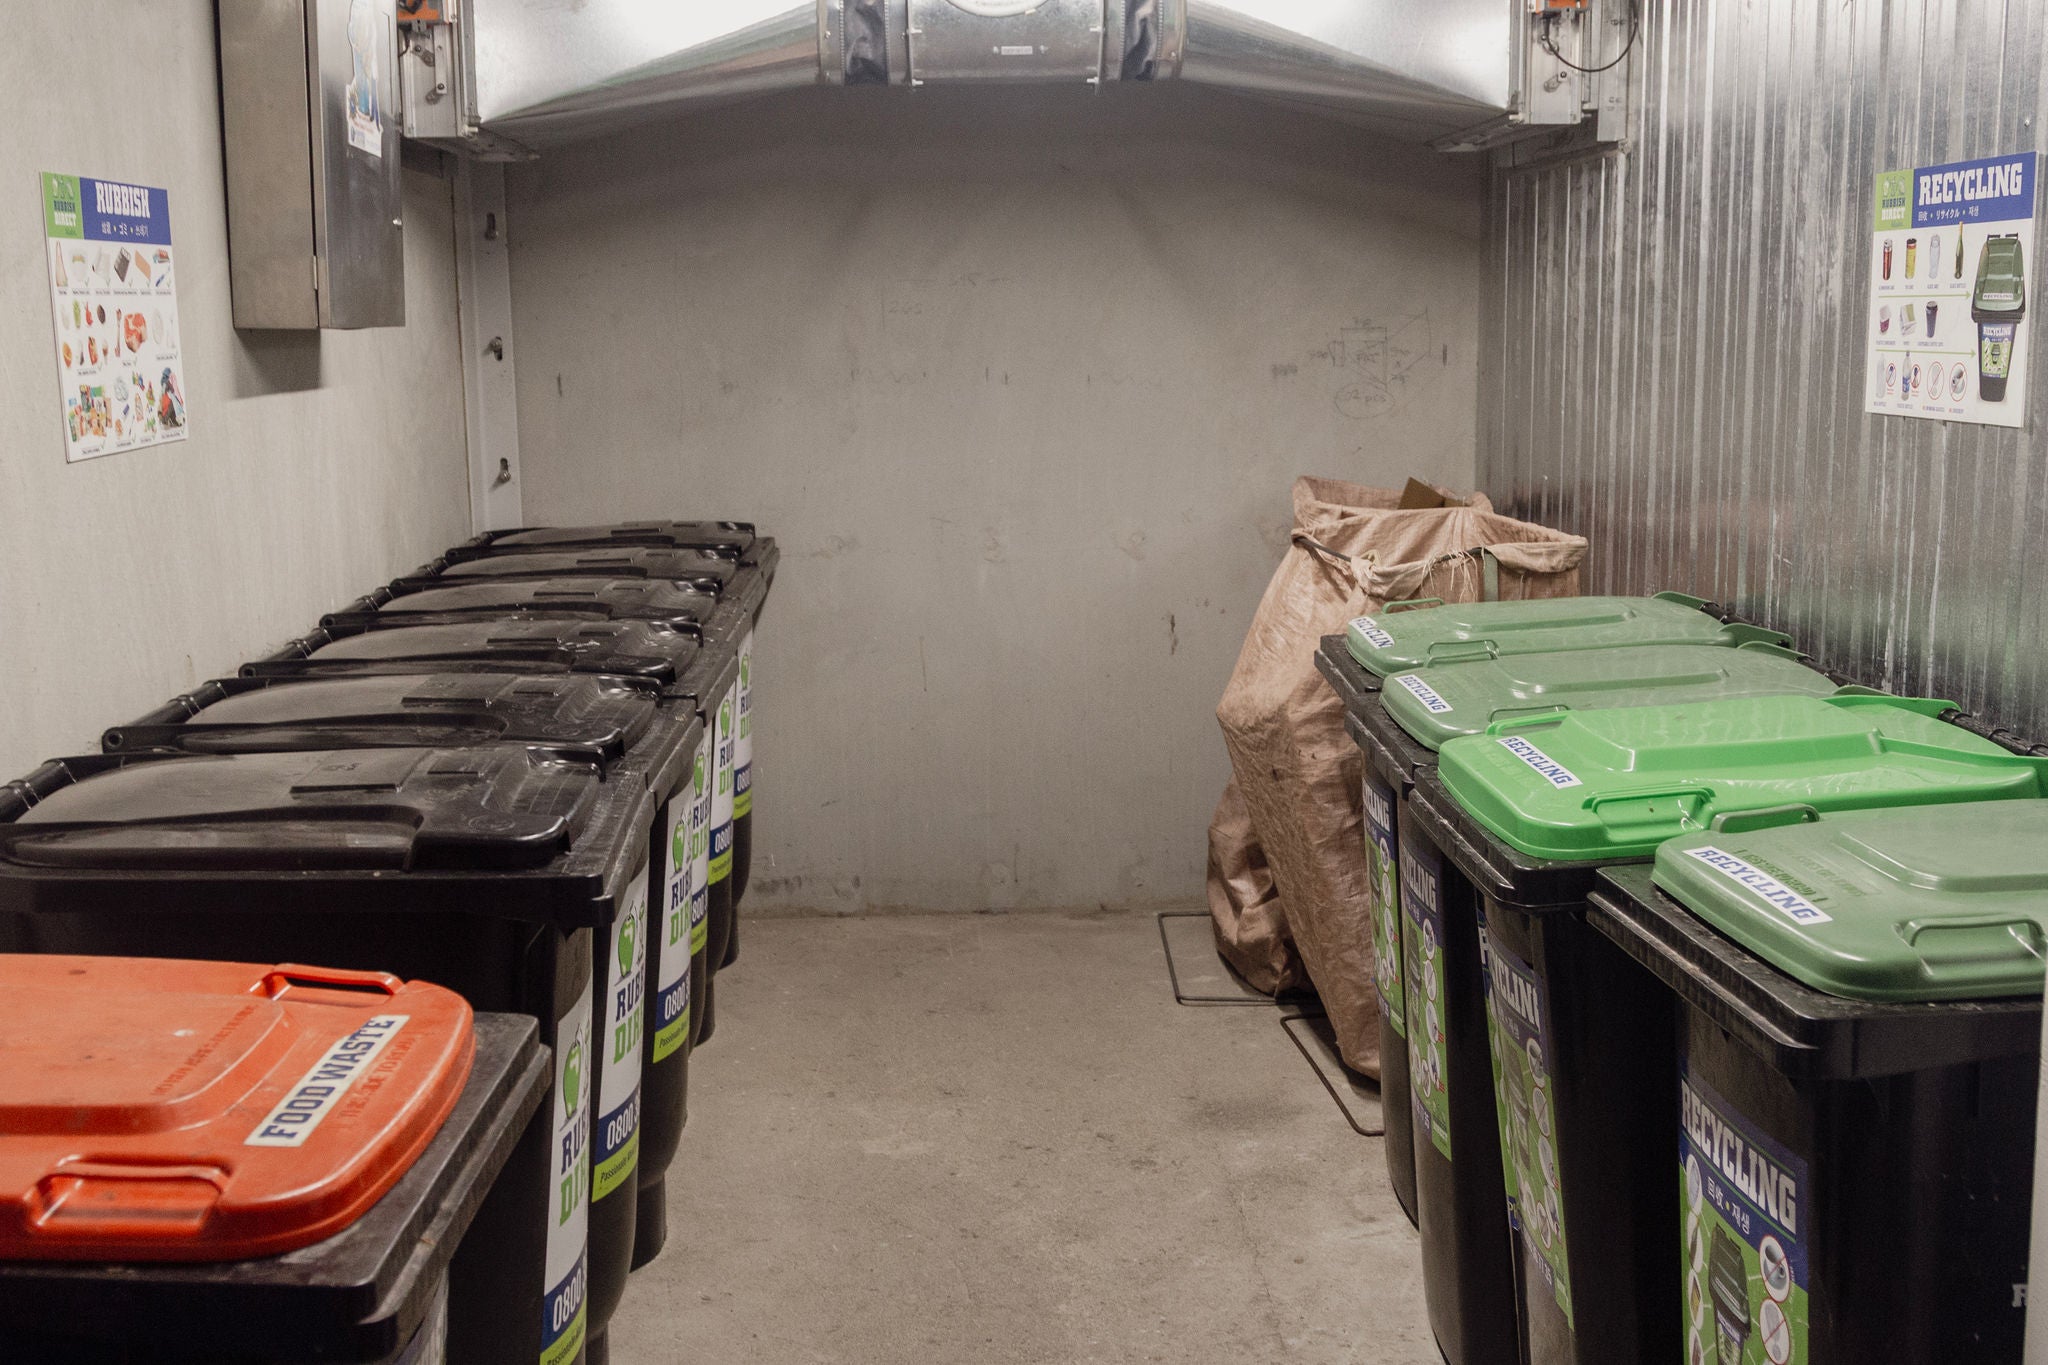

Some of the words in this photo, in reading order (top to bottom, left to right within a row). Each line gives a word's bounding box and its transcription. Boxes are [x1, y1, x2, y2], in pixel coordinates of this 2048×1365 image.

[53, 200, 76, 213] RUBBISH
[95, 181, 151, 219] RUBBISH
[1882, 197, 1906, 208] RUBBISH
[1918, 162, 2023, 206] RECYCLING
[1400, 676, 1447, 711] RECYCLING
[1501, 736, 1573, 785] RECYCLING
[1695, 848, 1820, 921] RECYCLING
[257, 1085, 336, 1139] FOOD
[310, 1018, 397, 1082] WASTE
[606, 1101, 634, 1152] 0800
[1681, 1079, 1797, 1235] RECYCLING
[552, 1266, 582, 1333] 0800
